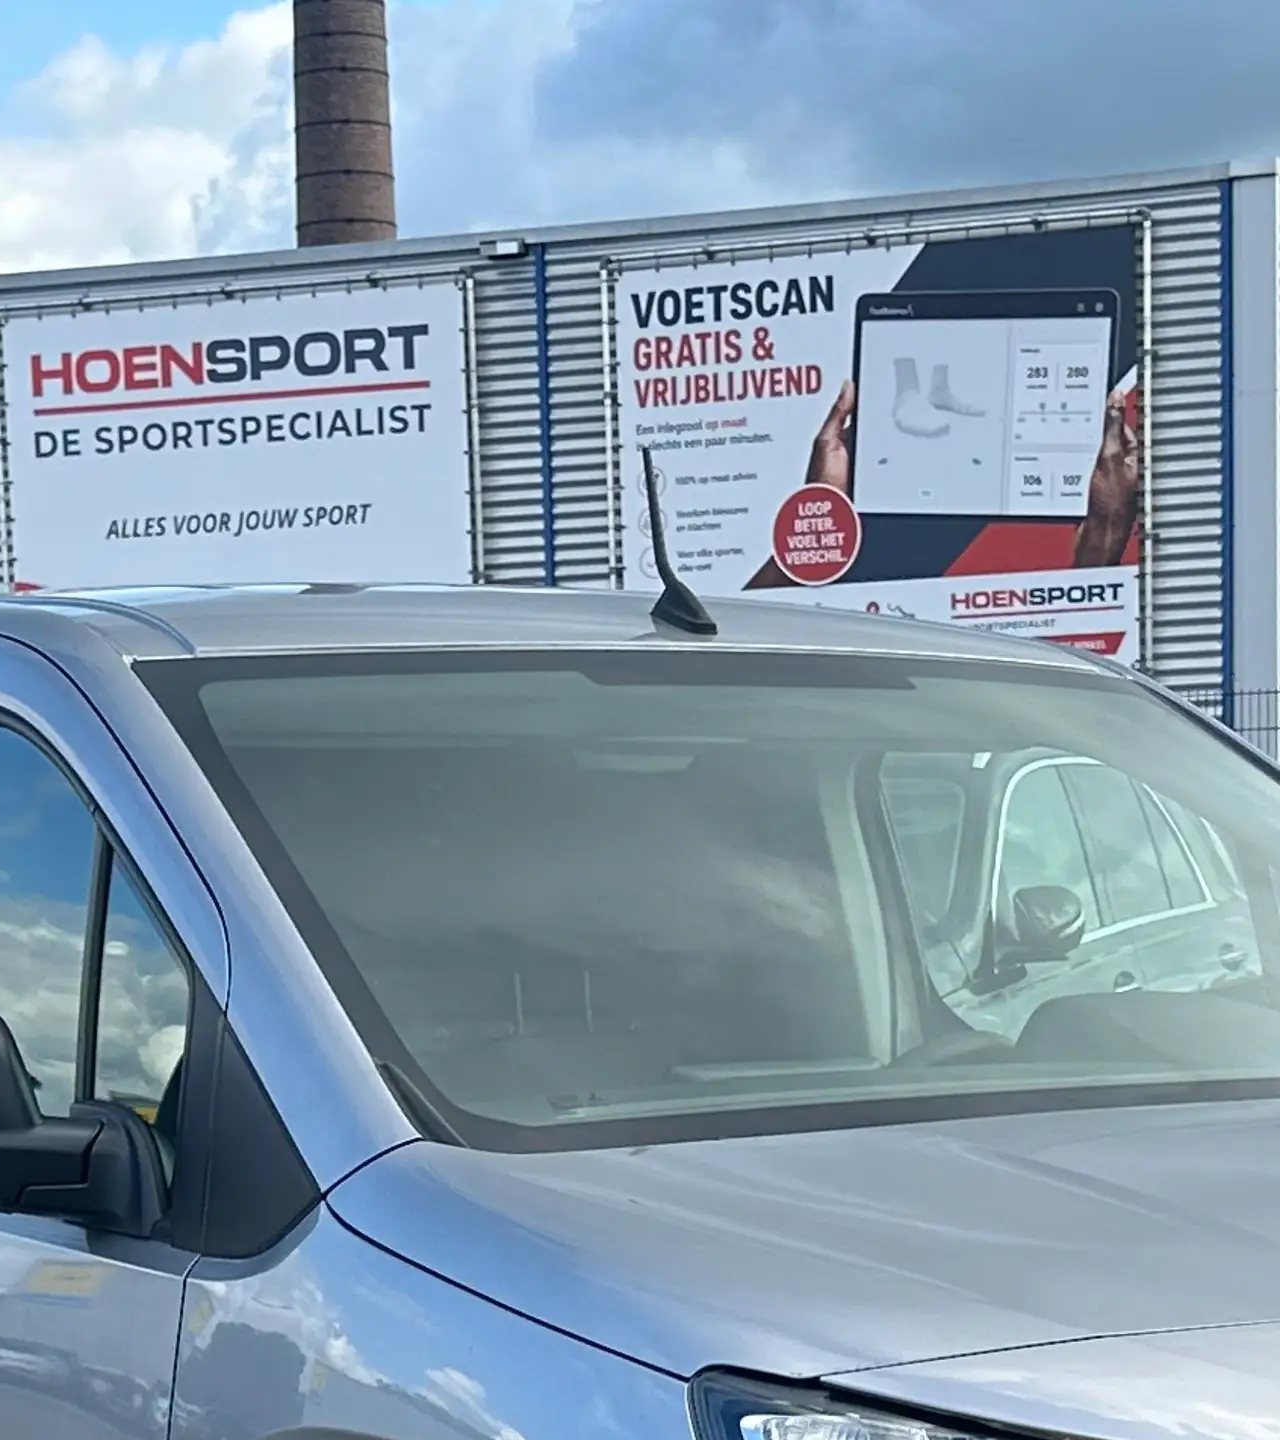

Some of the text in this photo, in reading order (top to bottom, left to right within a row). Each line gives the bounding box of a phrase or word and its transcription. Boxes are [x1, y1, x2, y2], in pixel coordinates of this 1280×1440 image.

[631, 275, 834, 328] VOETSCAN
[31, 324, 429, 396] HOENSPORT
[633, 326, 774, 371] GRATIS &
[634, 364, 823, 408] VRIJBLIJVEND
[34, 404, 431, 458] DE SPORTSPECIALIST
[106, 503, 372, 540] ALLES VOOR JOUW SPORT
[794, 517, 838, 533] BETER.
[798, 500, 832, 516] LOOP
[786, 532, 845, 549] VOEL HET
[950, 583, 1124, 610] HOENSPORT
